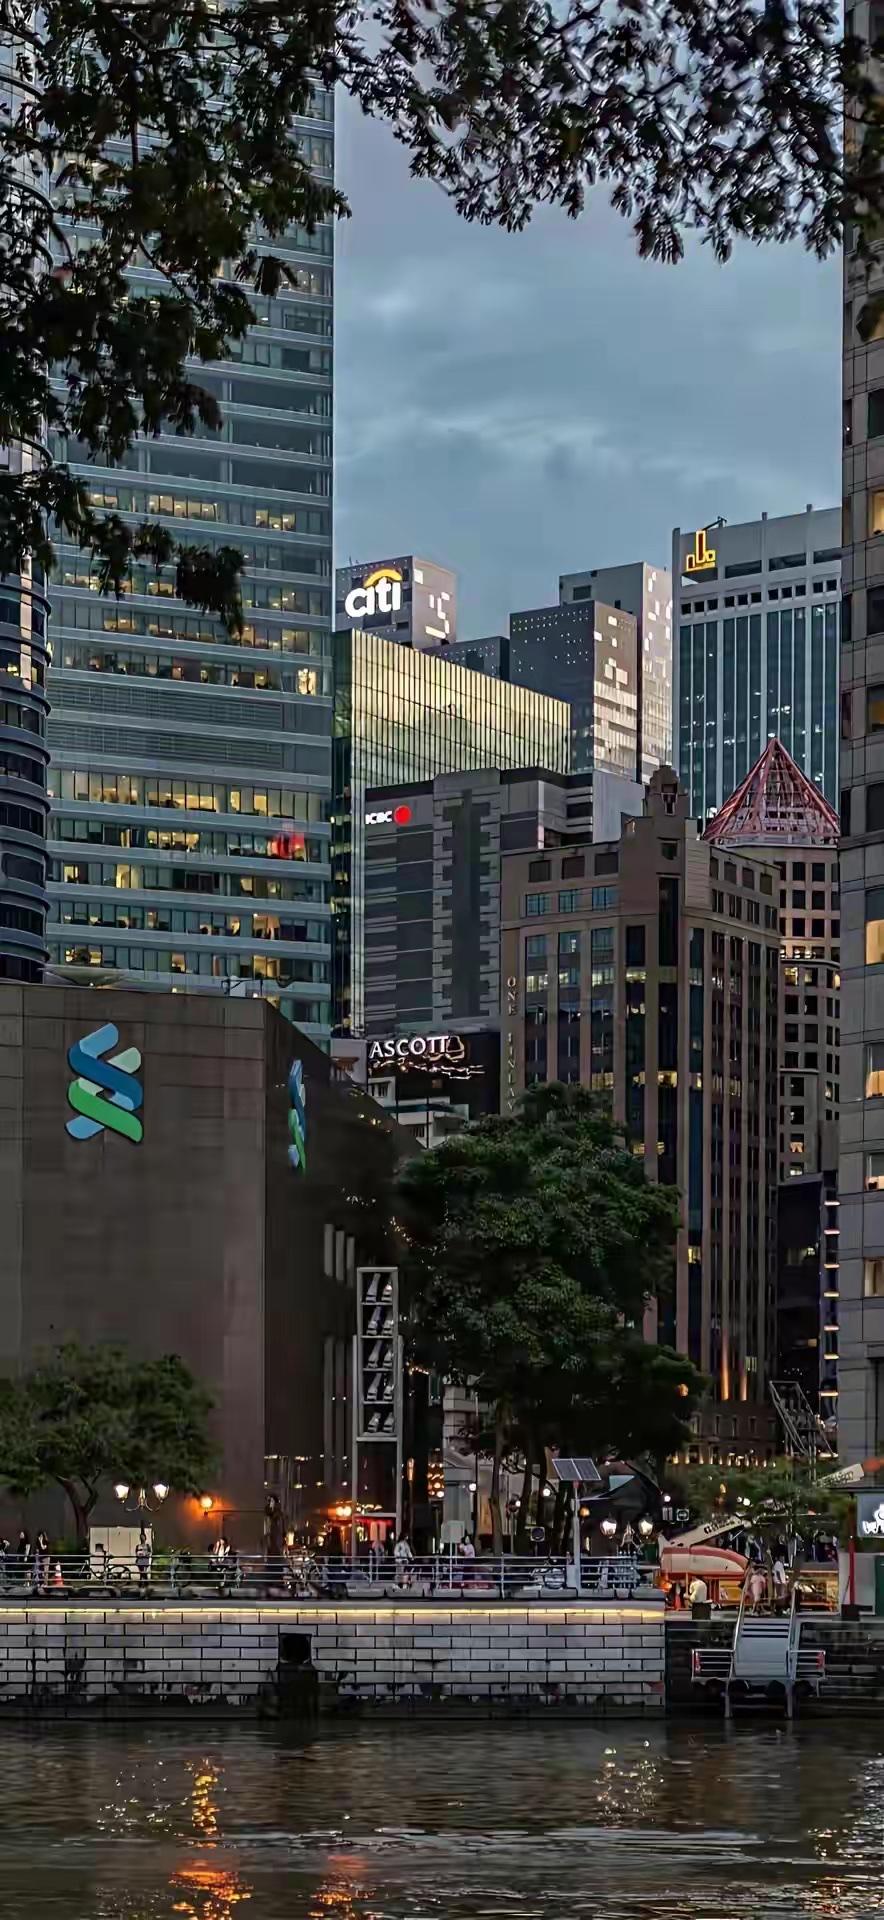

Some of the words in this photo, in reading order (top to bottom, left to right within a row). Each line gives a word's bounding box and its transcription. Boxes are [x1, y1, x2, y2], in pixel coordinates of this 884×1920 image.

[344, 574, 402, 618] citi
[365, 810, 393, 825] ICBC
[507, 976, 517, 1016] ONE
[369, 1035, 449, 1059] ASCOTT
